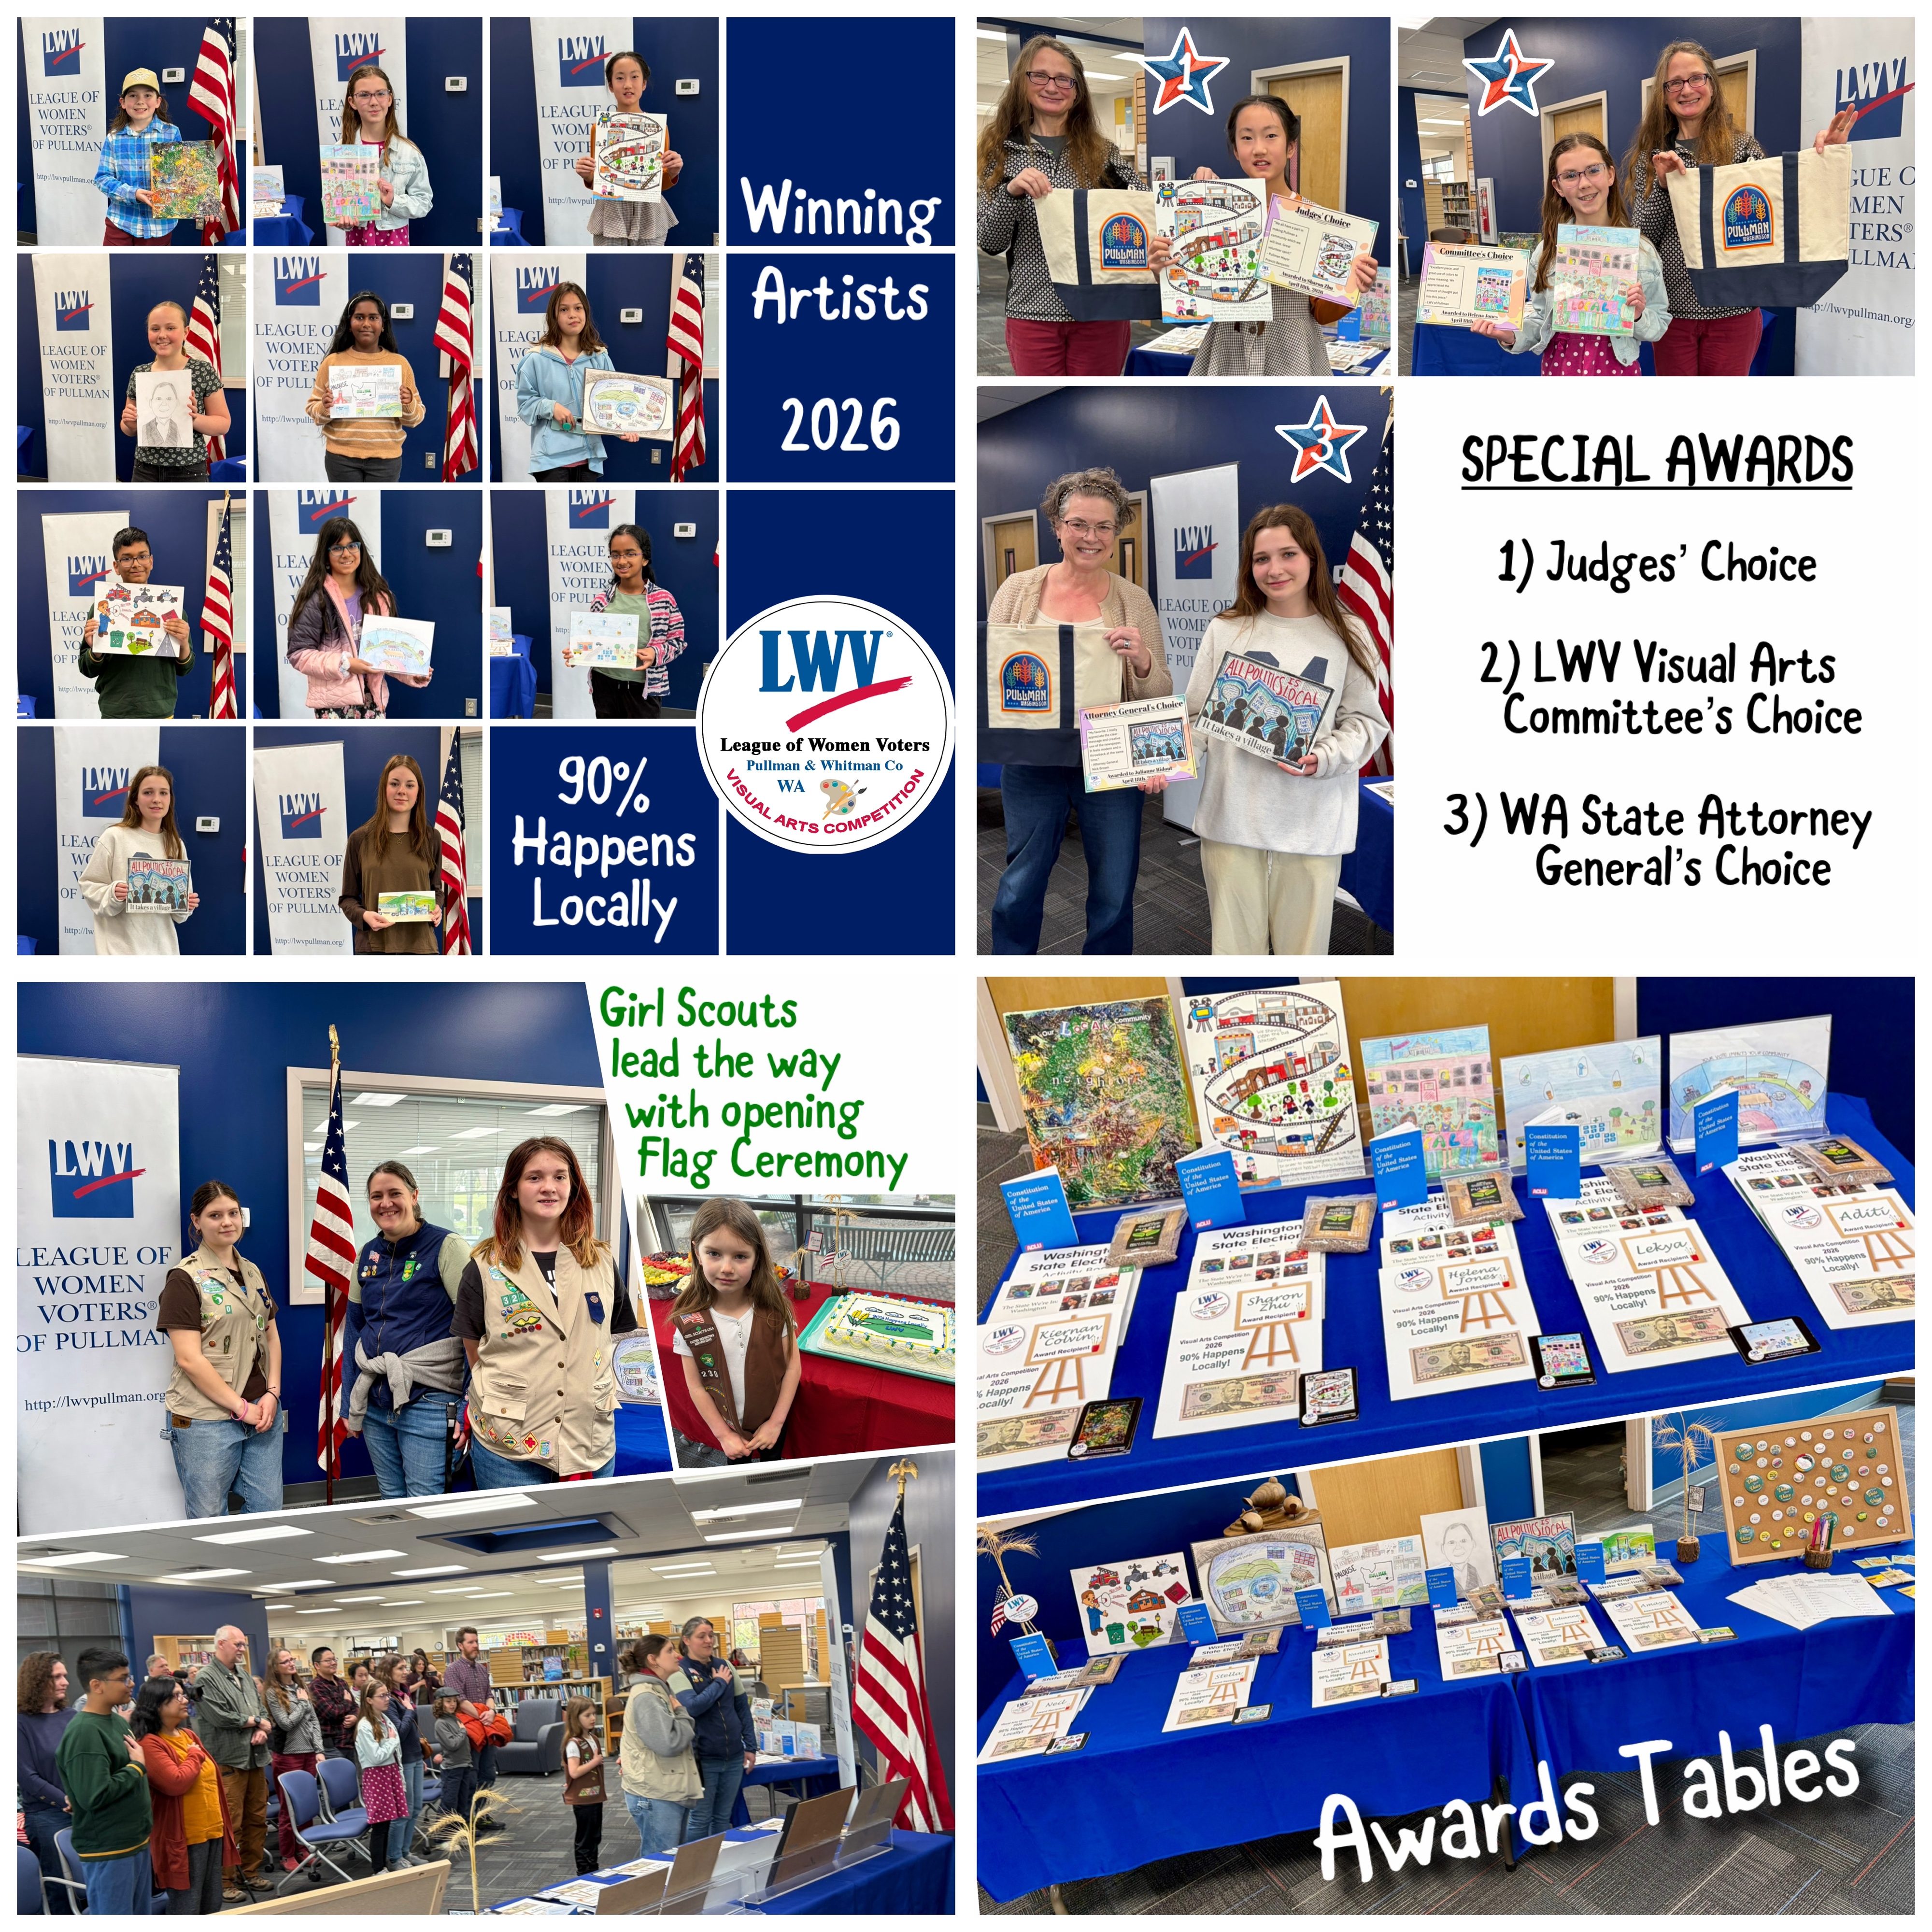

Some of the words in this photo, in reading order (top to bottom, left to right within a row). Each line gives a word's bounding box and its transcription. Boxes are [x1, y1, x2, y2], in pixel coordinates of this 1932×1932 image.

[43, 28, 79, 53] LWV
[1838, 57, 1906, 102] LWV
[30, 92, 78, 104] LEAGUE
[82, 91, 99, 103] OF
[38, 109, 85, 119] WOMEN
[32, 140, 44, 149] OF
[48, 141, 102, 152] PULLMAN
[1295, 206, 1324, 219] Judges'
[1324, 214, 1351, 228] Choice
[1728, 222, 1769, 238] PULLMAN
[1105, 248, 1145, 260] PULLMAN
[1440, 247, 1486, 258] Committee's
[1487, 252, 1513, 260] Choice
[275, 256, 319, 280] LWV
[1281, 271, 1301, 282] Awarded
[1307, 279, 1323, 288] Sharon
[1288, 280, 1300, 289] April
[1311, 286, 1323, 295] 2026
[330, 381, 348, 390] PALOUSE
[48, 418, 107, 428] http://lwvpullman.org/
[1176, 525, 1212, 552] LWV
[1224, 659, 1244, 677] ALL
[1245, 663, 1285, 696] POLITICS
[1287, 678, 1301, 687] IS
[1006, 689, 1046, 701] PULLMAN
[1282, 687, 1320, 705] LOCAL
[1083, 710, 1117, 720] Attorney
[1119, 704, 1155, 715] General's
[1156, 701, 1183, 710] Choice
[1202, 719, 1212, 728] It
[1211, 724, 1235, 740] takes
[1235, 734, 1241, 742] a
[1243, 737, 1272, 754] village
[1042, 1029, 1054, 1037] Our
[1114, 1014, 1151, 1024] Community
[1052, 1075, 1143, 1087] neighbors
[52, 1140, 131, 1177] LWV
[1181, 1161, 1222, 1175] Constitution
[1185, 1179, 1209, 1189] United
[1210, 1174, 1229, 1184] States
[1195, 1182, 1222, 1193] America
[1839, 1206, 1890, 1221] Aditi
[1196, 1220, 1211, 1228] ACLU
[1636, 1239, 1688, 1255] Lekya
[136, 1247, 172, 1264] OF
[33, 1275, 145, 1296] WOMEN
[1247, 1292, 1303, 1307] Sharon
[1260, 1302, 1291, 1312] Zhu
[885, 1316, 906, 1324] Happens
[1241, 1315, 1264, 1324] Award
[1264, 1311, 1296, 1321] Recipient
[1039, 1324, 1102, 1339] Kiernan
[1213, 1331, 1250, 1342] Competition
[17, 1334, 47, 1353] OF
[1044, 1334, 1094, 1346] Colvin
[1179, 1352, 1200, 1363] 90%
[1202, 1348, 1245, 1360] Happens
[1192, 1359, 1230, 1371] Locally!
[1640, 1600, 1670, 1610] Amaya
[1348, 1649, 1376, 1657] Nandita
[1214, 1671, 1242, 1680] Stella
